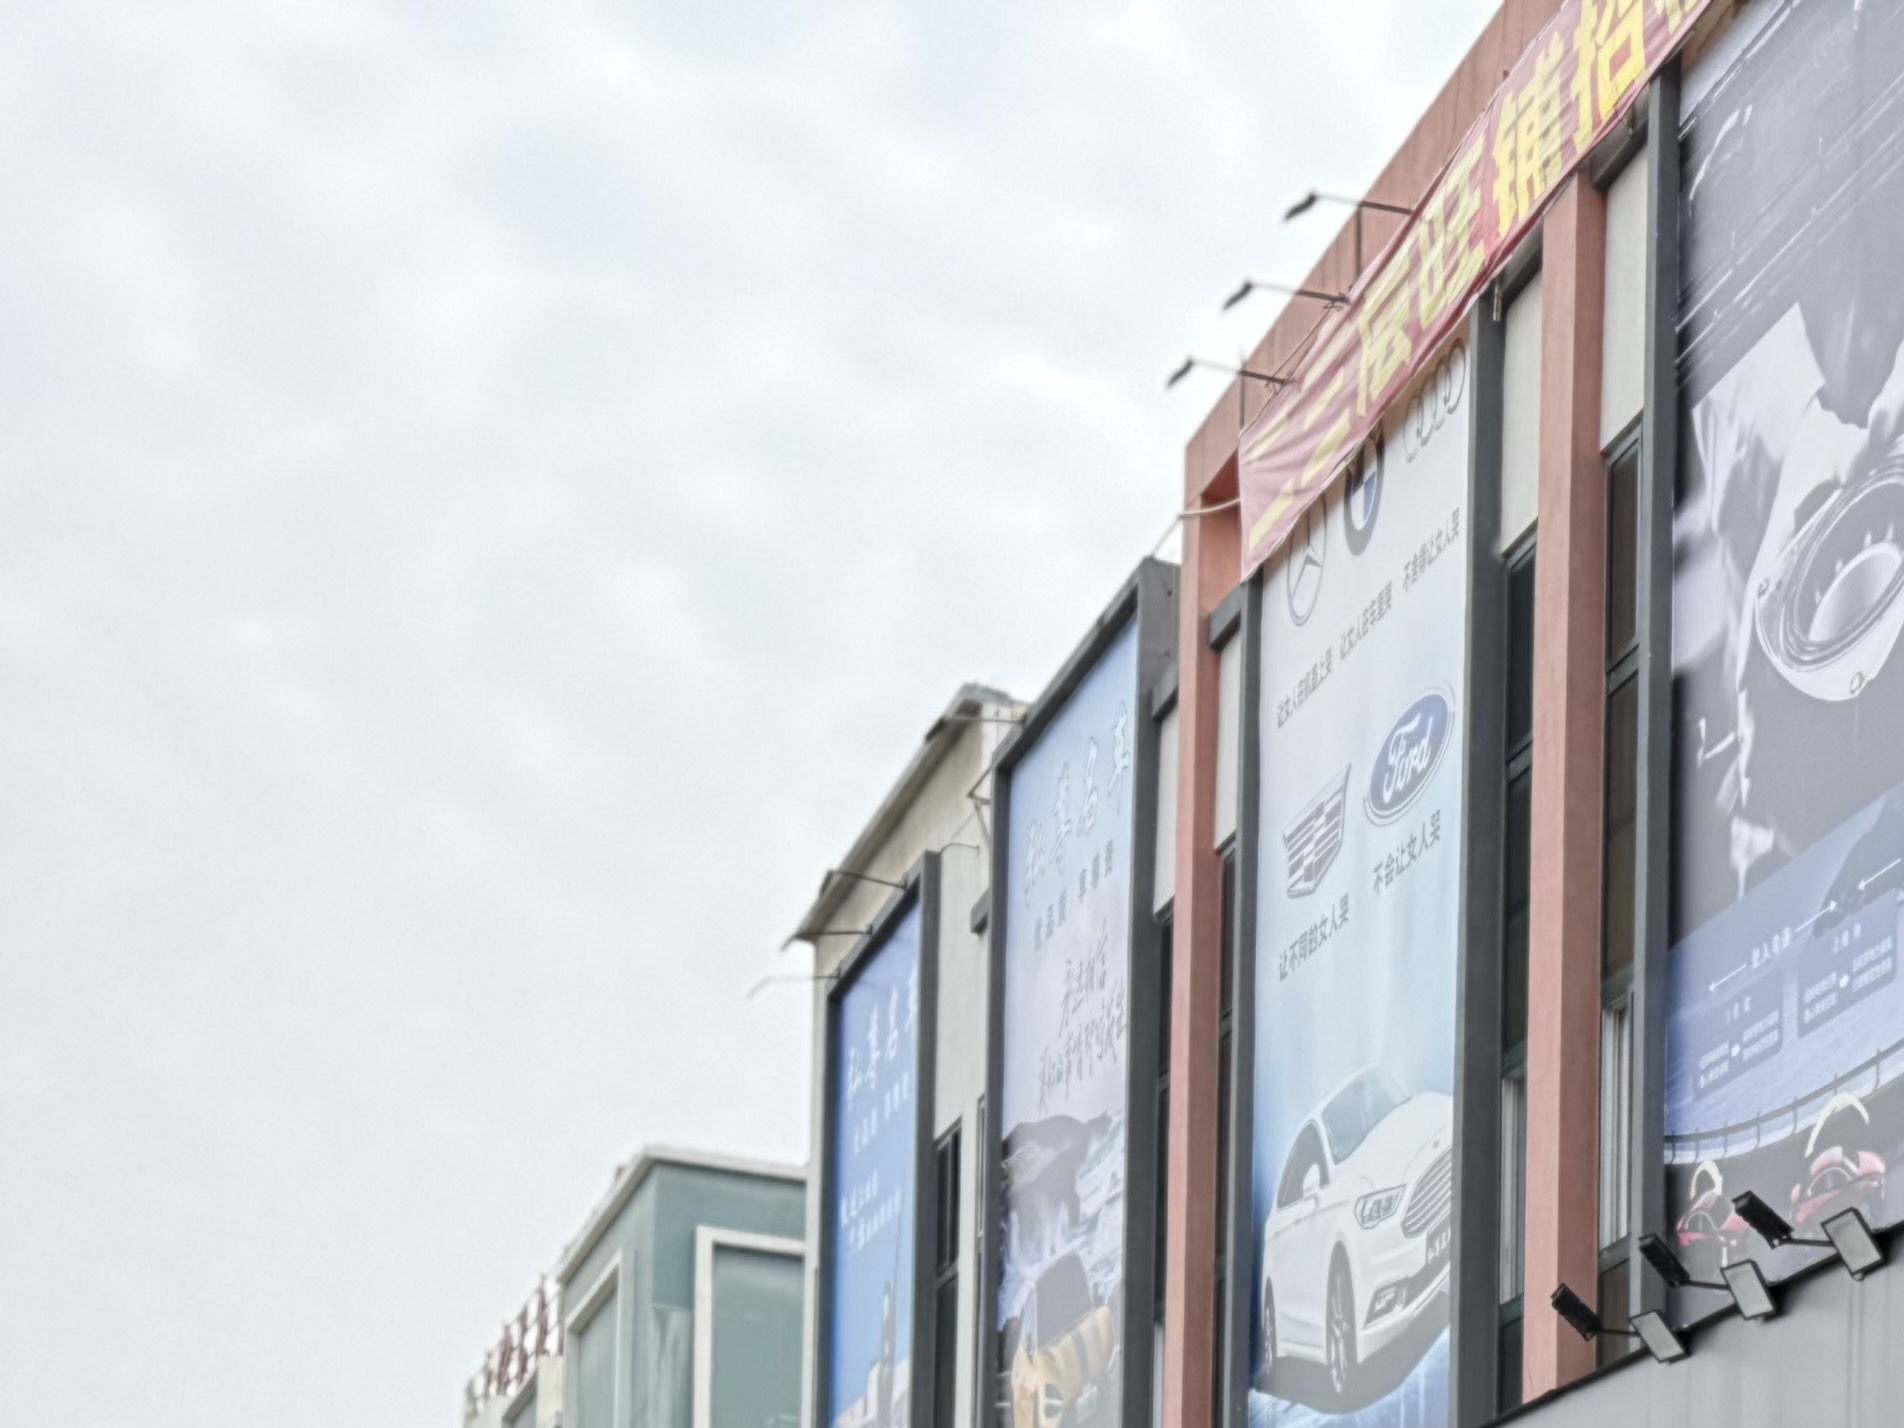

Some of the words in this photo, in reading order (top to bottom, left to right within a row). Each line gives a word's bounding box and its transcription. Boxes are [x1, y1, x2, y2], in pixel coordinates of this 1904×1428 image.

[1248, 0, 1702, 550] 二三层旺铺招
